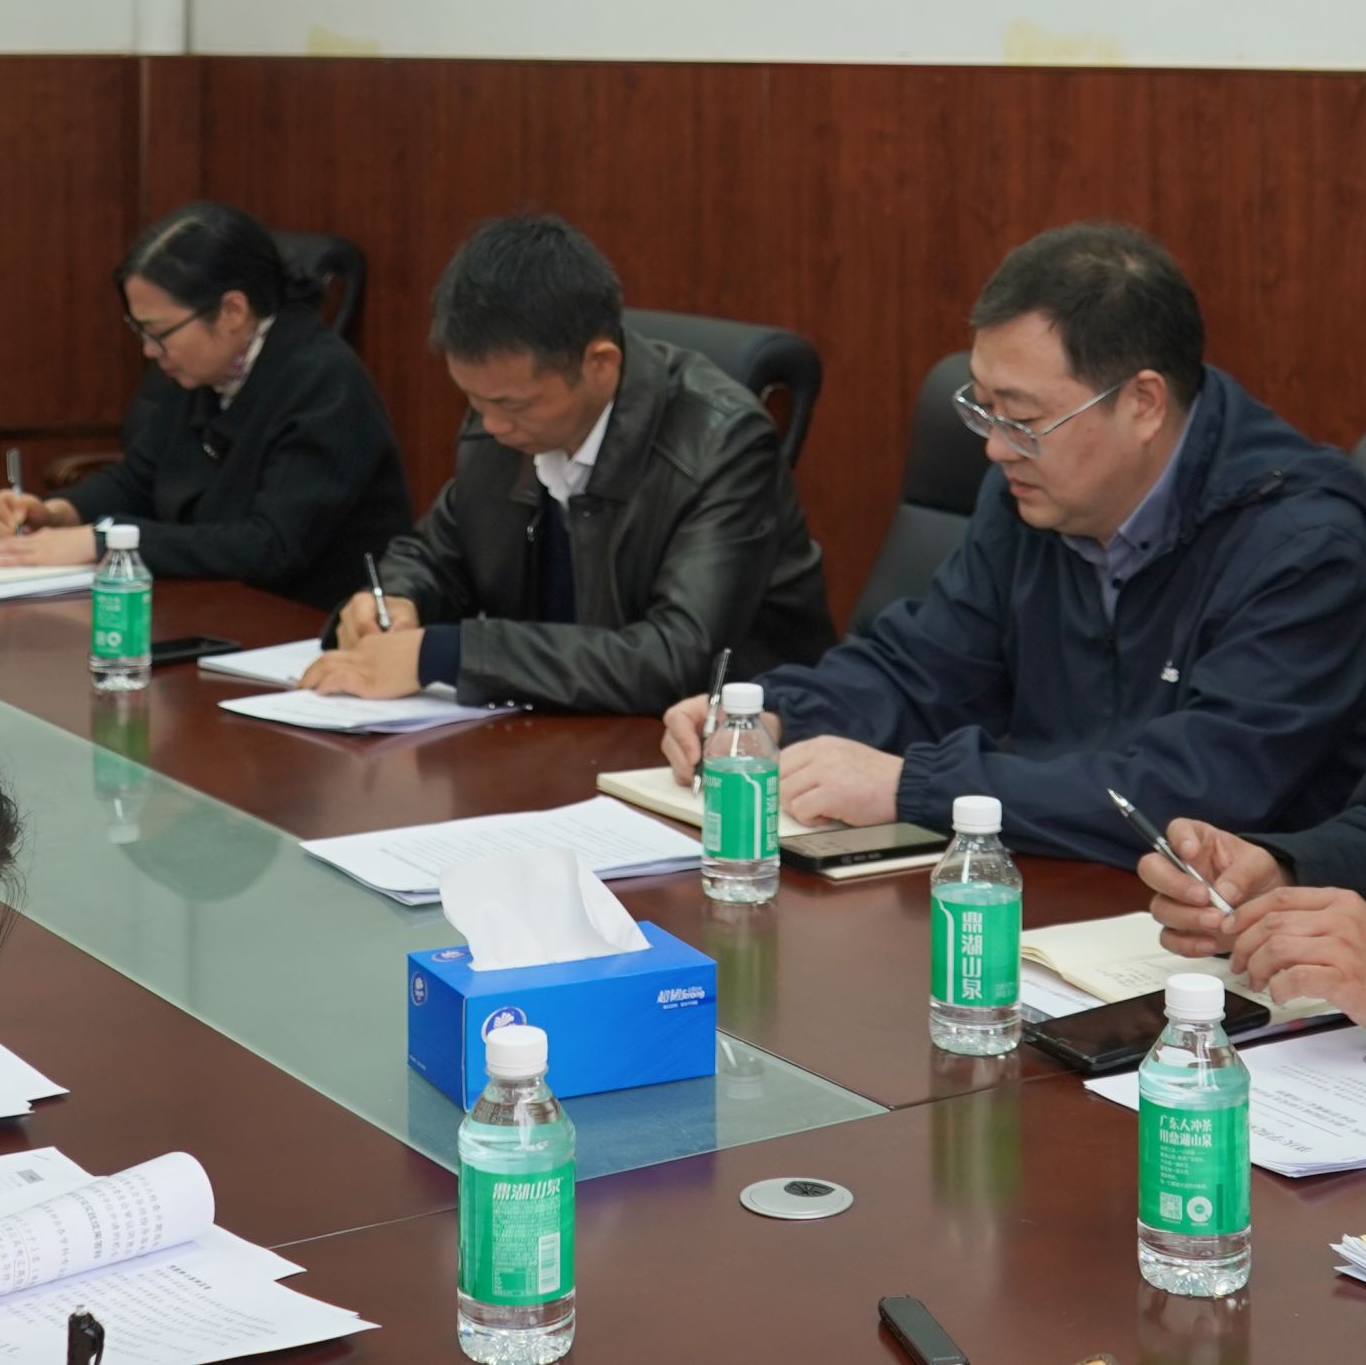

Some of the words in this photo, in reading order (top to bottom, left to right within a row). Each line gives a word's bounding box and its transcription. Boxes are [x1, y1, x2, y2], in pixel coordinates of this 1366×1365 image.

[961, 911, 983, 1000] 鼎湖山泉
[1159, 1114, 1212, 1132] 广东人冲茶
[492, 1178, 560, 1201] 鼎湖山泉
